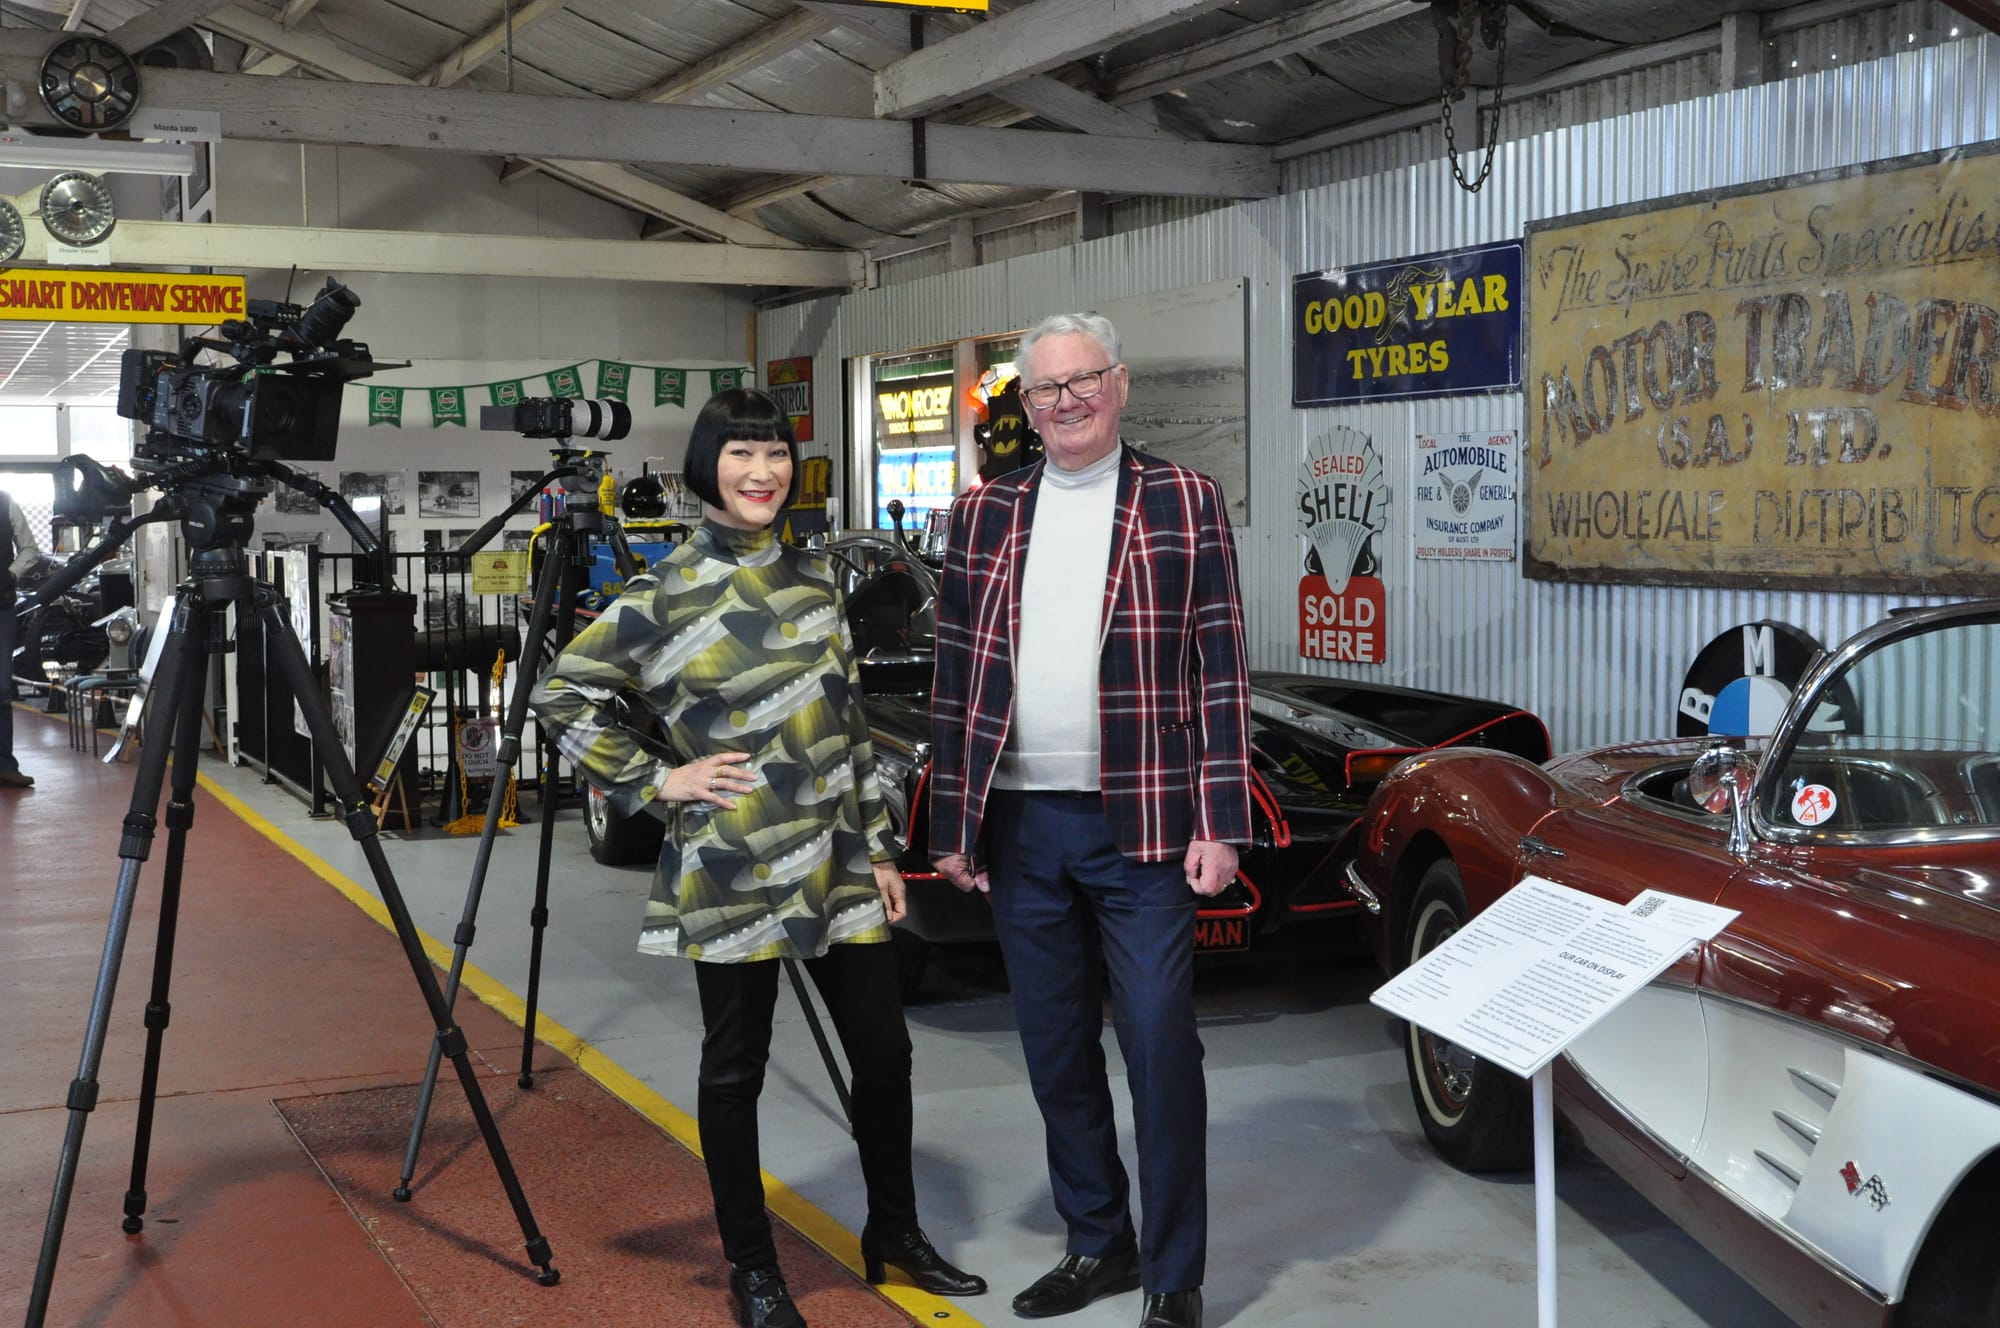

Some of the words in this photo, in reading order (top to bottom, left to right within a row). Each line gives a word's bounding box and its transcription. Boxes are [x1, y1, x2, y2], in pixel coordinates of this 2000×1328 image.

[1550, 245, 1601, 324] The
[1605, 233, 1698, 319] Spare
[1704, 220, 1788, 290] Parts
[1797, 191, 2000, 288] Specialis
[0, 279, 66, 309] SMART
[71, 281, 168, 312] DRIVEWAY
[170, 284, 243, 313] SERVICE
[1305, 291, 1386, 335] GOOD
[1409, 273, 1509, 321] YEAR
[1346, 340, 1449, 380] TYRES
[1539, 310, 1720, 469] MOTOR
[1735, 290, 2000, 418] TRADER
[879, 386, 952, 421] MONROE
[1419, 439, 1437, 449] LOCAL
[1488, 435, 1512, 446] AGENCY
[1458, 434, 1471, 443] THE
[1313, 455, 1364, 478] SEALED
[1423, 446, 1507, 476] AUTOMOBILE
[1301, 482, 1375, 530] SHELL
[1417, 486, 1433, 501] FIRE
[1436, 486, 1442, 501] &
[1480, 485, 1513, 501] GENERAL
[1426, 516, 1468, 535] INSURANCE
[1470, 514, 1504, 534] COMPANY
[1548, 490, 1724, 542] WHOLESALE
[1417, 547, 1436, 557] POLICY
[1438, 547, 1462, 557] HOLDERS
[1464, 548, 1481, 557] SHARE
[1483, 548, 1488, 557] IN
[1490, 548, 1512, 558] PROFITS
[1305, 594, 1376, 628] SOLD
[1305, 628, 1373, 663] HERE
[1559, 951, 1576, 961] OUR
[1573, 957, 1589, 966] CAR
[1586, 962, 1600, 970] ON
[1597, 966, 1626, 980] DISPLAY
